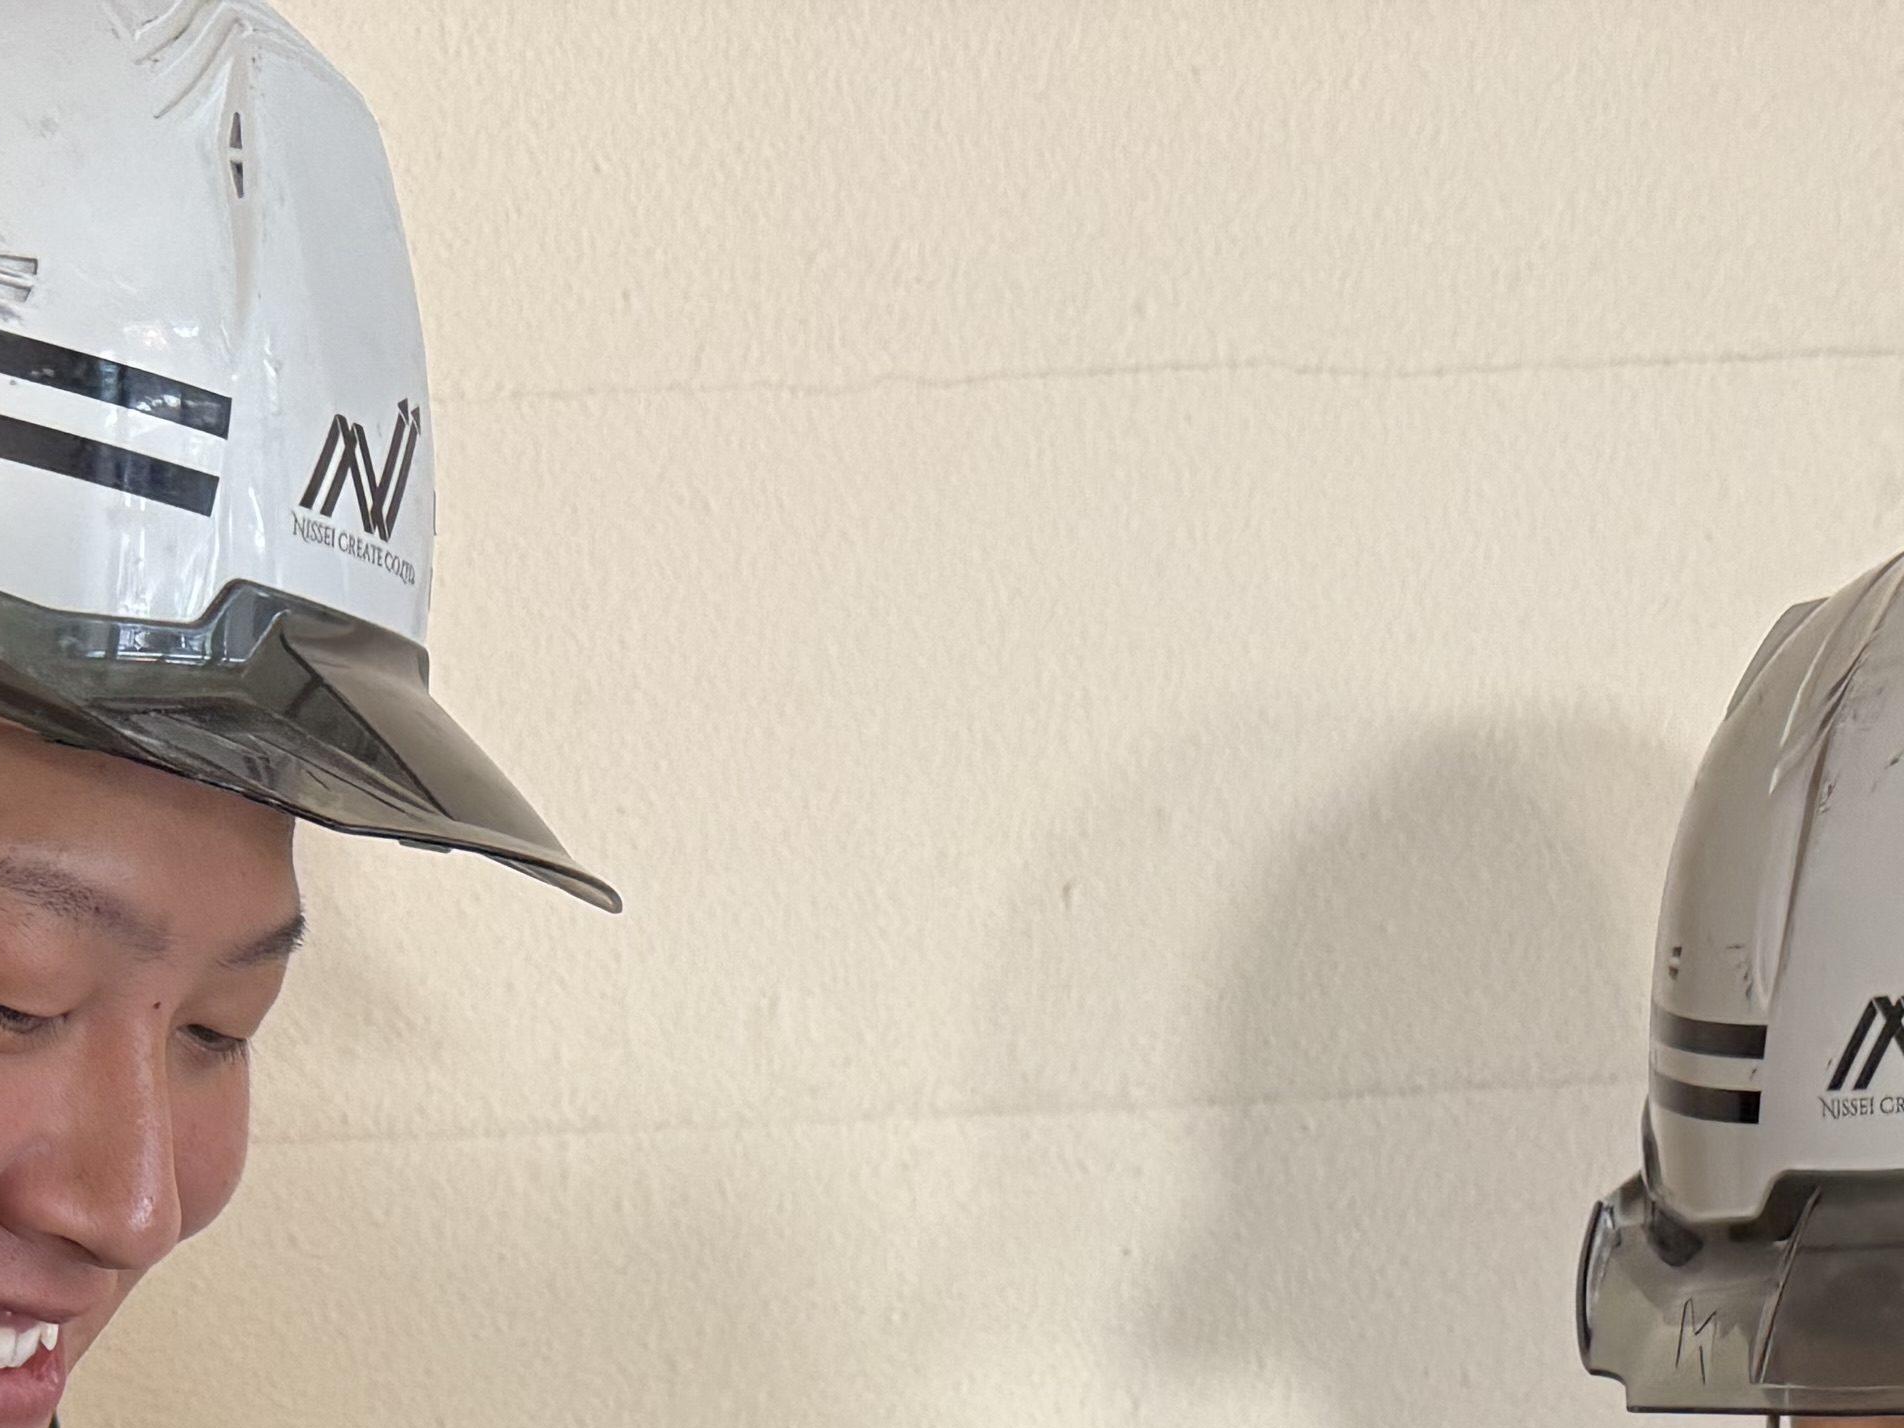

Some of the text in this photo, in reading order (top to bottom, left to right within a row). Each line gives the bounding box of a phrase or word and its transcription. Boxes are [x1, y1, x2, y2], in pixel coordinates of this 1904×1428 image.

[291, 510, 336, 548] NISSEI
[338, 532, 384, 568] CREATE
[1818, 1095, 1875, 1119] NISSEI
